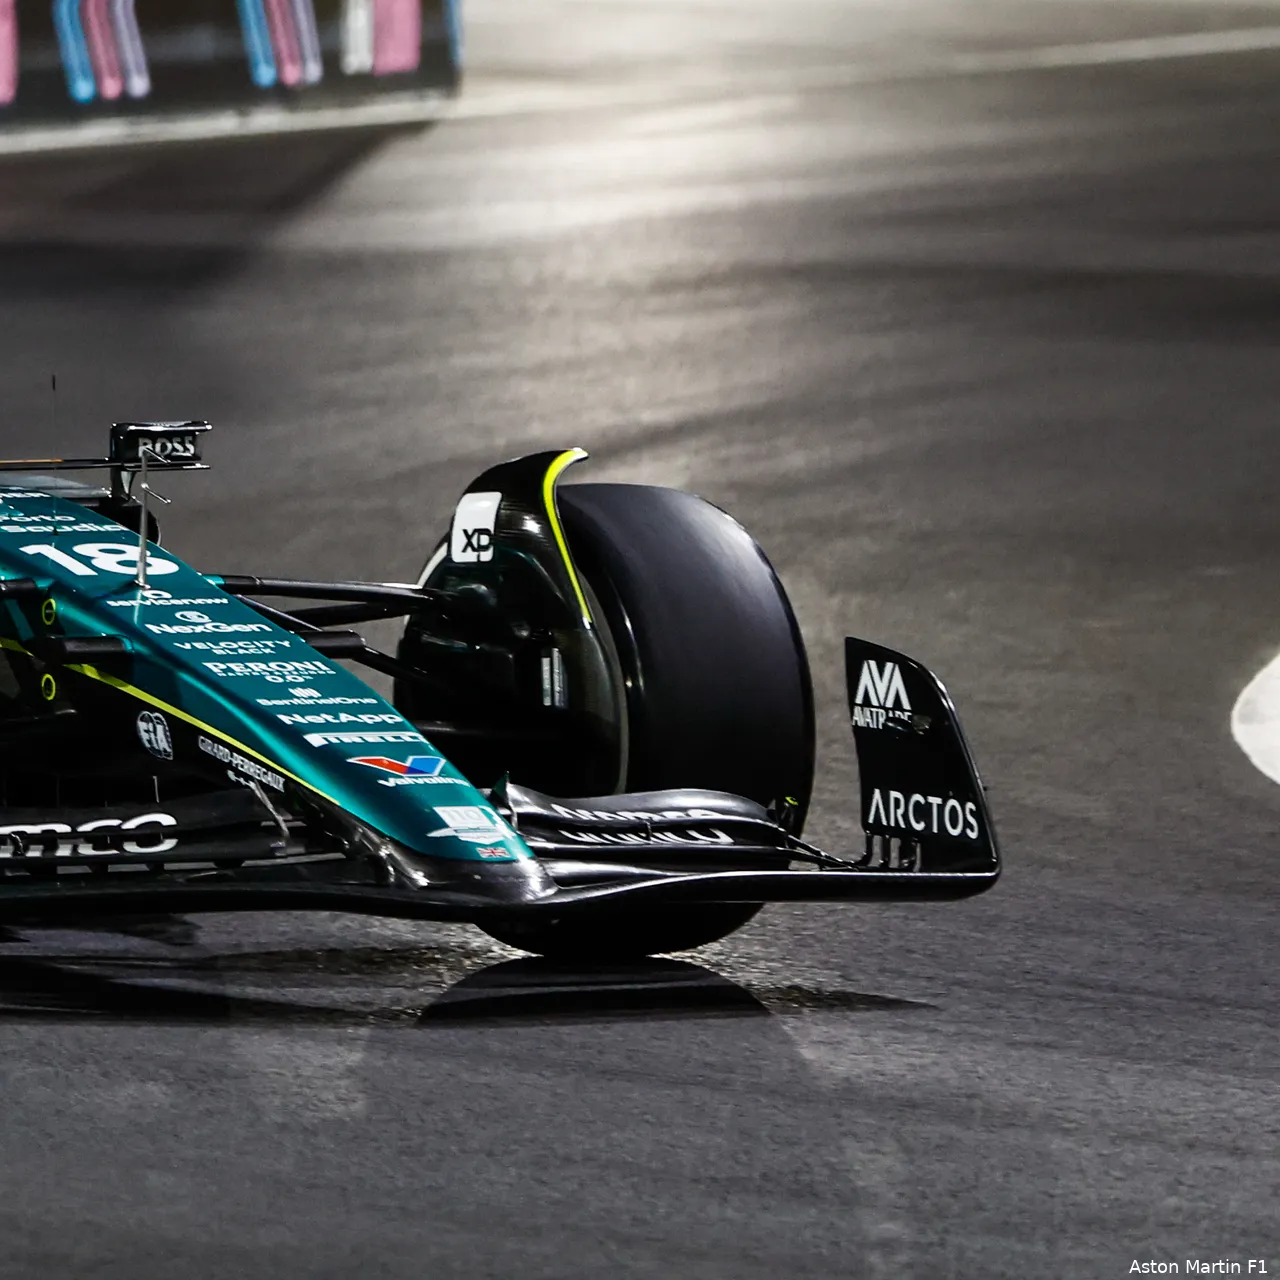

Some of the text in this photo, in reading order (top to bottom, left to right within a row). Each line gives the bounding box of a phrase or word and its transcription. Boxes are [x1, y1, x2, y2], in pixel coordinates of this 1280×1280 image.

[138, 436, 196, 458] BOSS
[18, 542, 180, 576] 18
[145, 622, 273, 635] NexGen
[173, 640, 292, 650] VELOCITY
[202, 661, 332, 674] PERONI
[255, 697, 379, 706] SentinelOne
[277, 712, 404, 725] NetApp
[868, 788, 979, 840] ARCTOS
